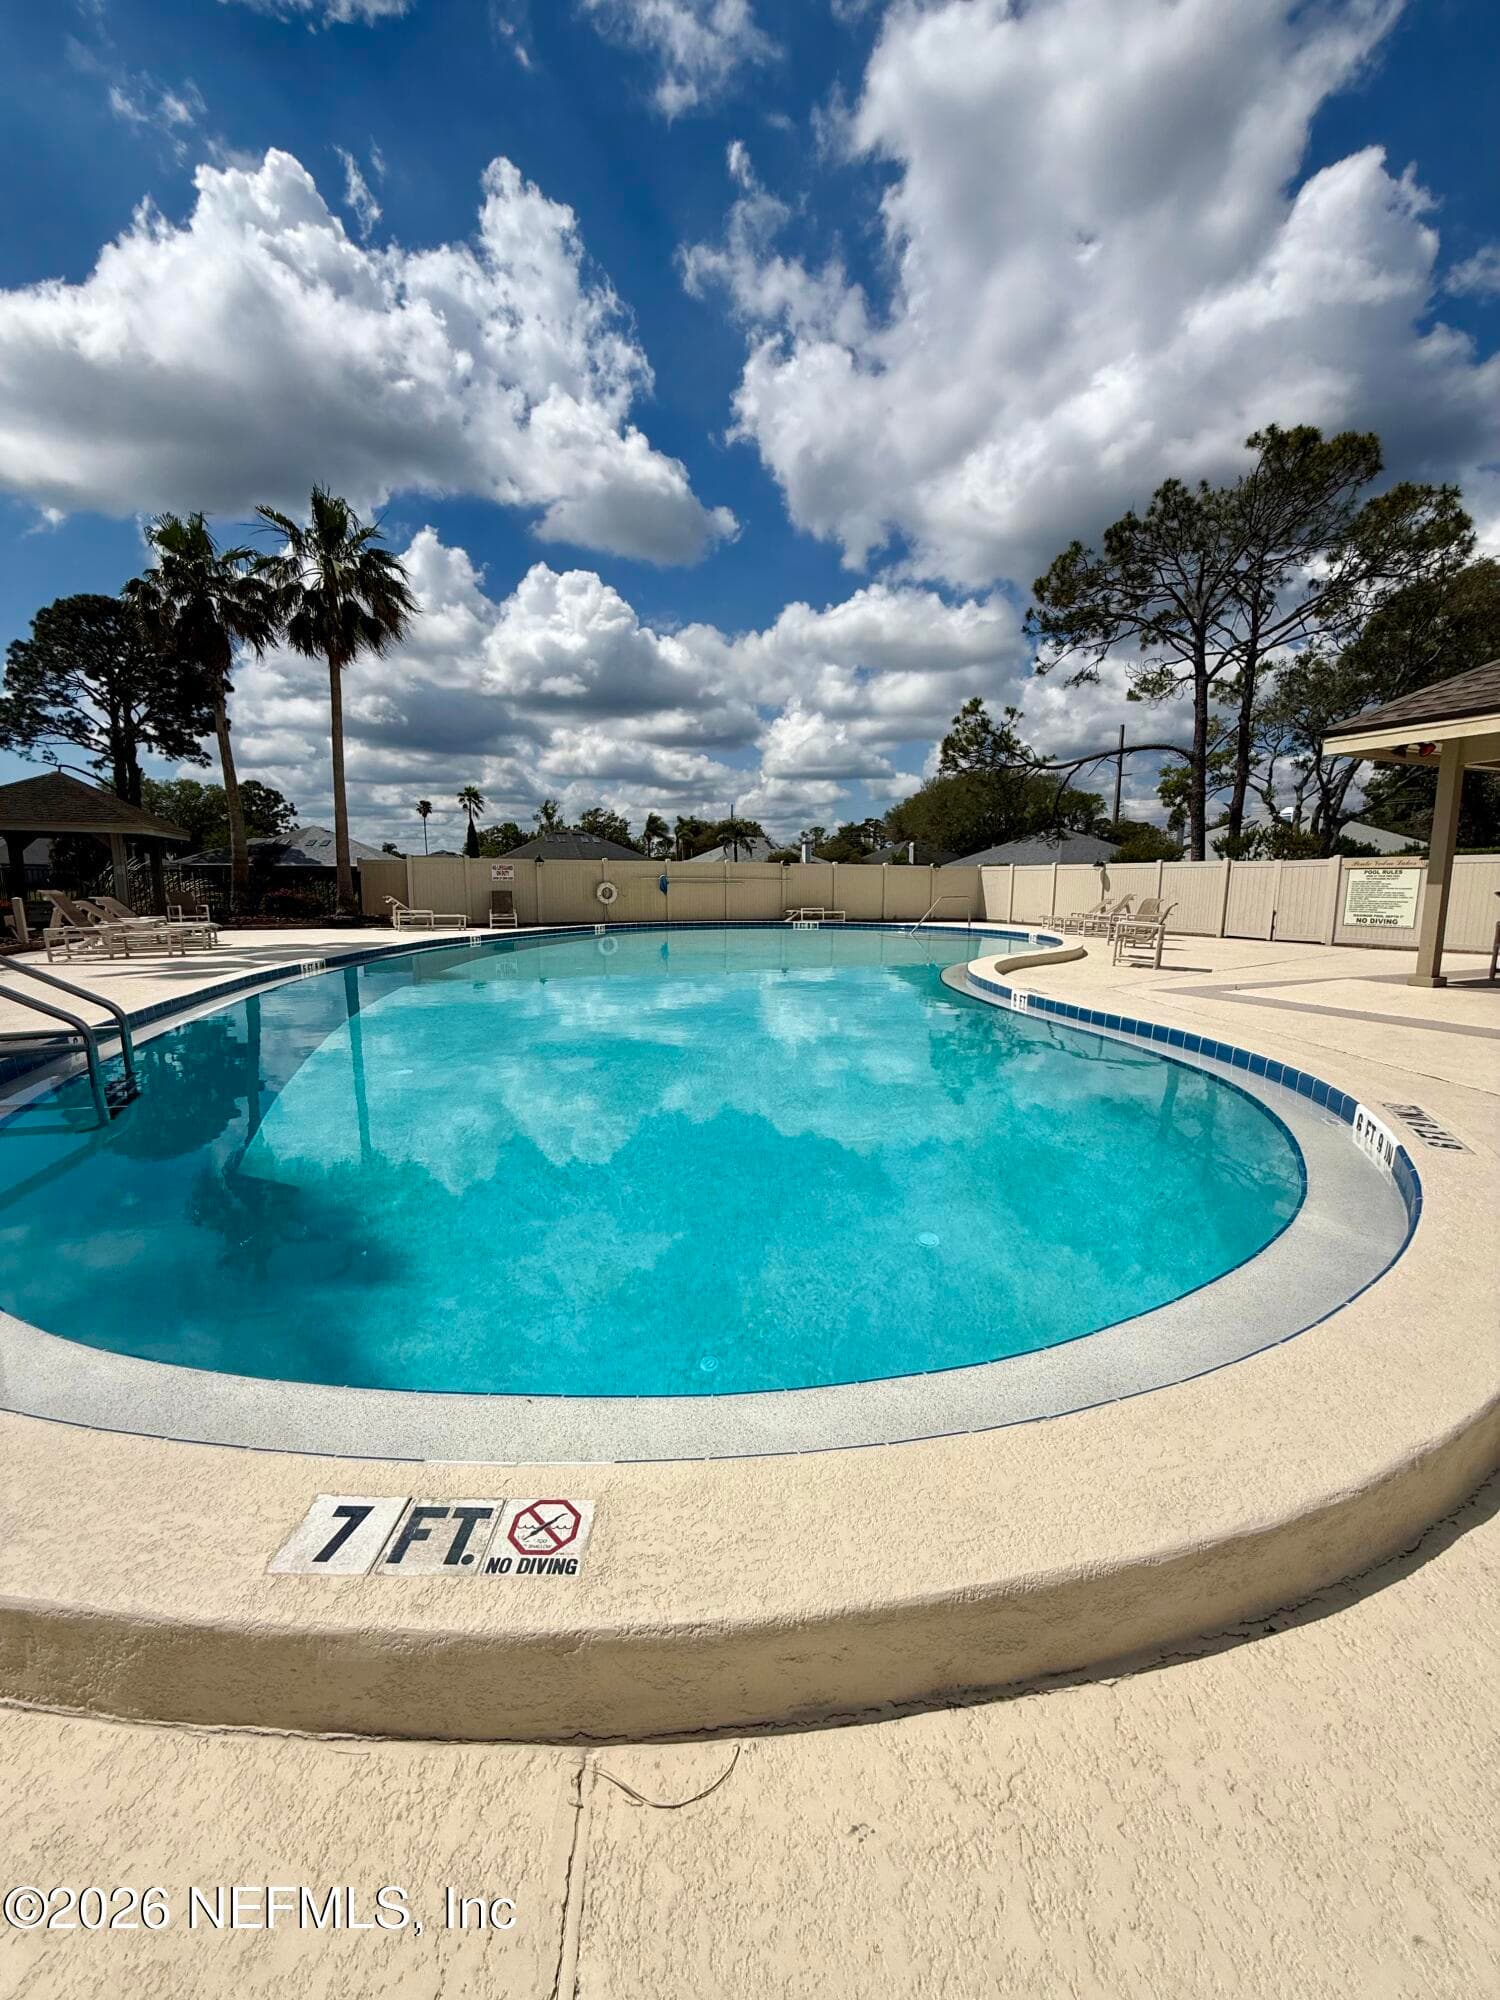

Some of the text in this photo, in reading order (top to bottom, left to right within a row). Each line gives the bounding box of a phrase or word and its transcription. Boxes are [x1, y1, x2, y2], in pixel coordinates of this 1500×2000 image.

[1356, 1112, 1393, 1166] 6 FT 9 IN
[311, 1505, 494, 1565] 7 FT.
[485, 1557, 579, 1575] NO DIVING
